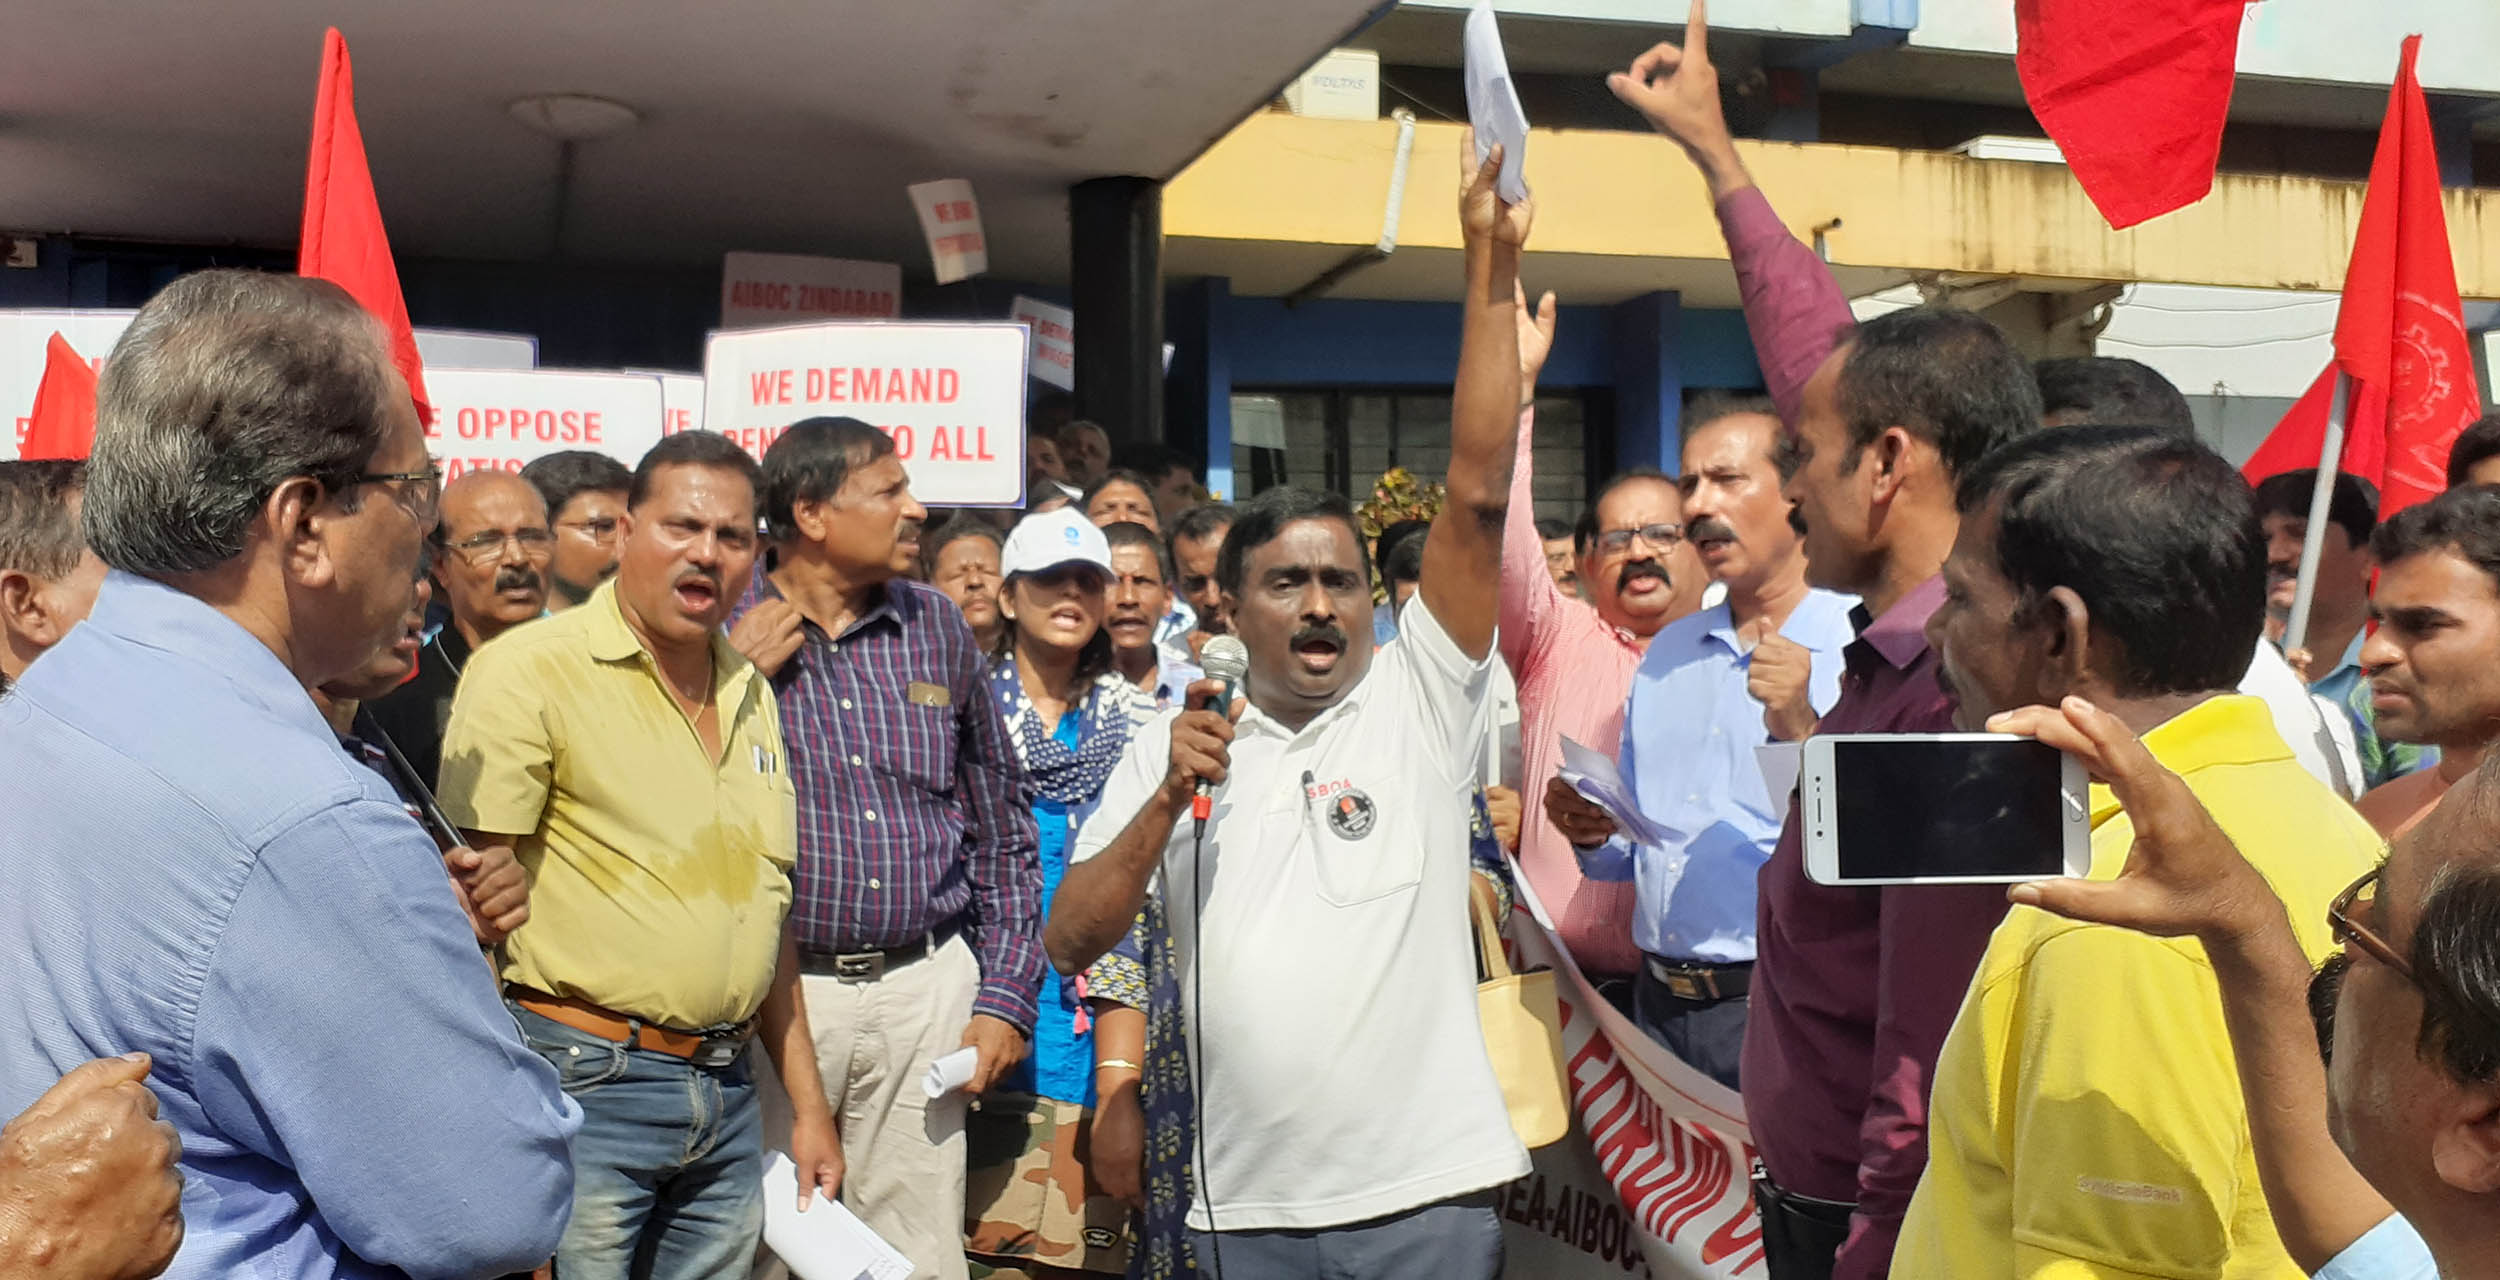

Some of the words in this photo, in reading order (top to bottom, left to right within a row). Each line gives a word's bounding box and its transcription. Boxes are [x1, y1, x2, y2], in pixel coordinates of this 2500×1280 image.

[732, 279, 791, 311] AIBOC
[797, 284, 894, 317] ZINDABAD
[751, 370, 793, 406] WE
[806, 367, 960, 404] DEMAND
[457, 407, 603, 444] OPPOSE
[877, 424, 914, 460] O
[929, 425, 996, 461] ALL
[1307, 777, 1352, 799] SBOA
